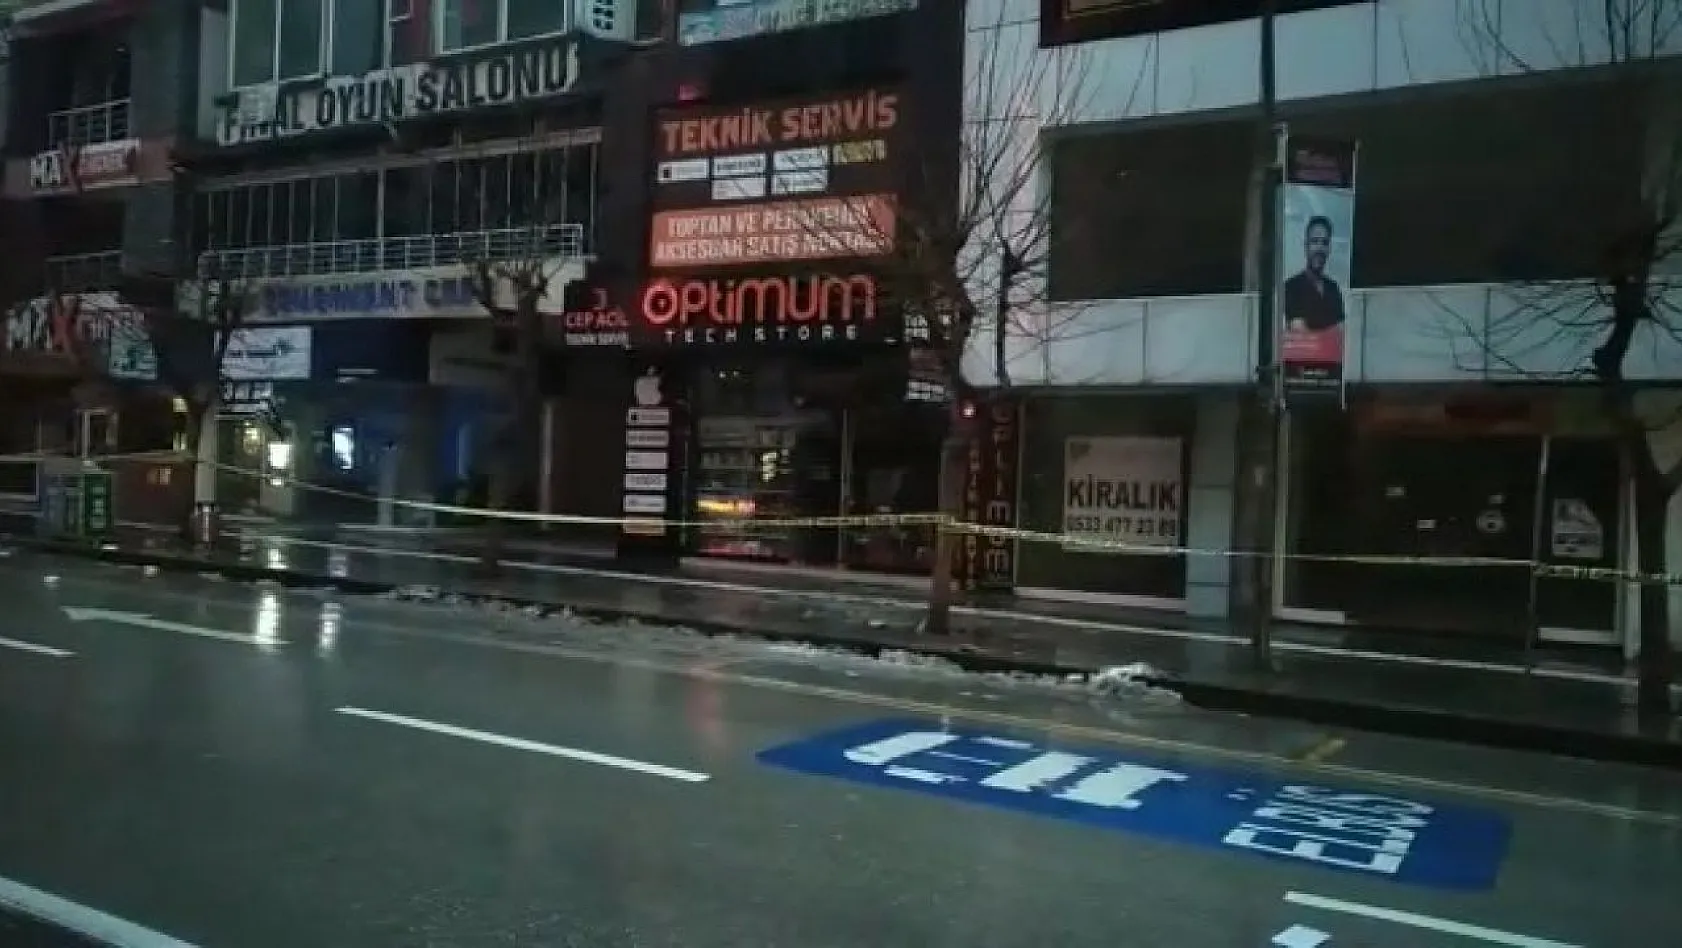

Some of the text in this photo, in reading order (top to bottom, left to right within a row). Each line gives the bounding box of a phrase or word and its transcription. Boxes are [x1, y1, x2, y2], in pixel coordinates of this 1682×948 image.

[417, 44, 577, 112] SALONU
[660, 88, 898, 153] TEKNİK SERVİS
[736, 211, 759, 233] VE
[664, 324, 859, 344] TECH STORE
[1067, 473, 1178, 512] KİRALIK
